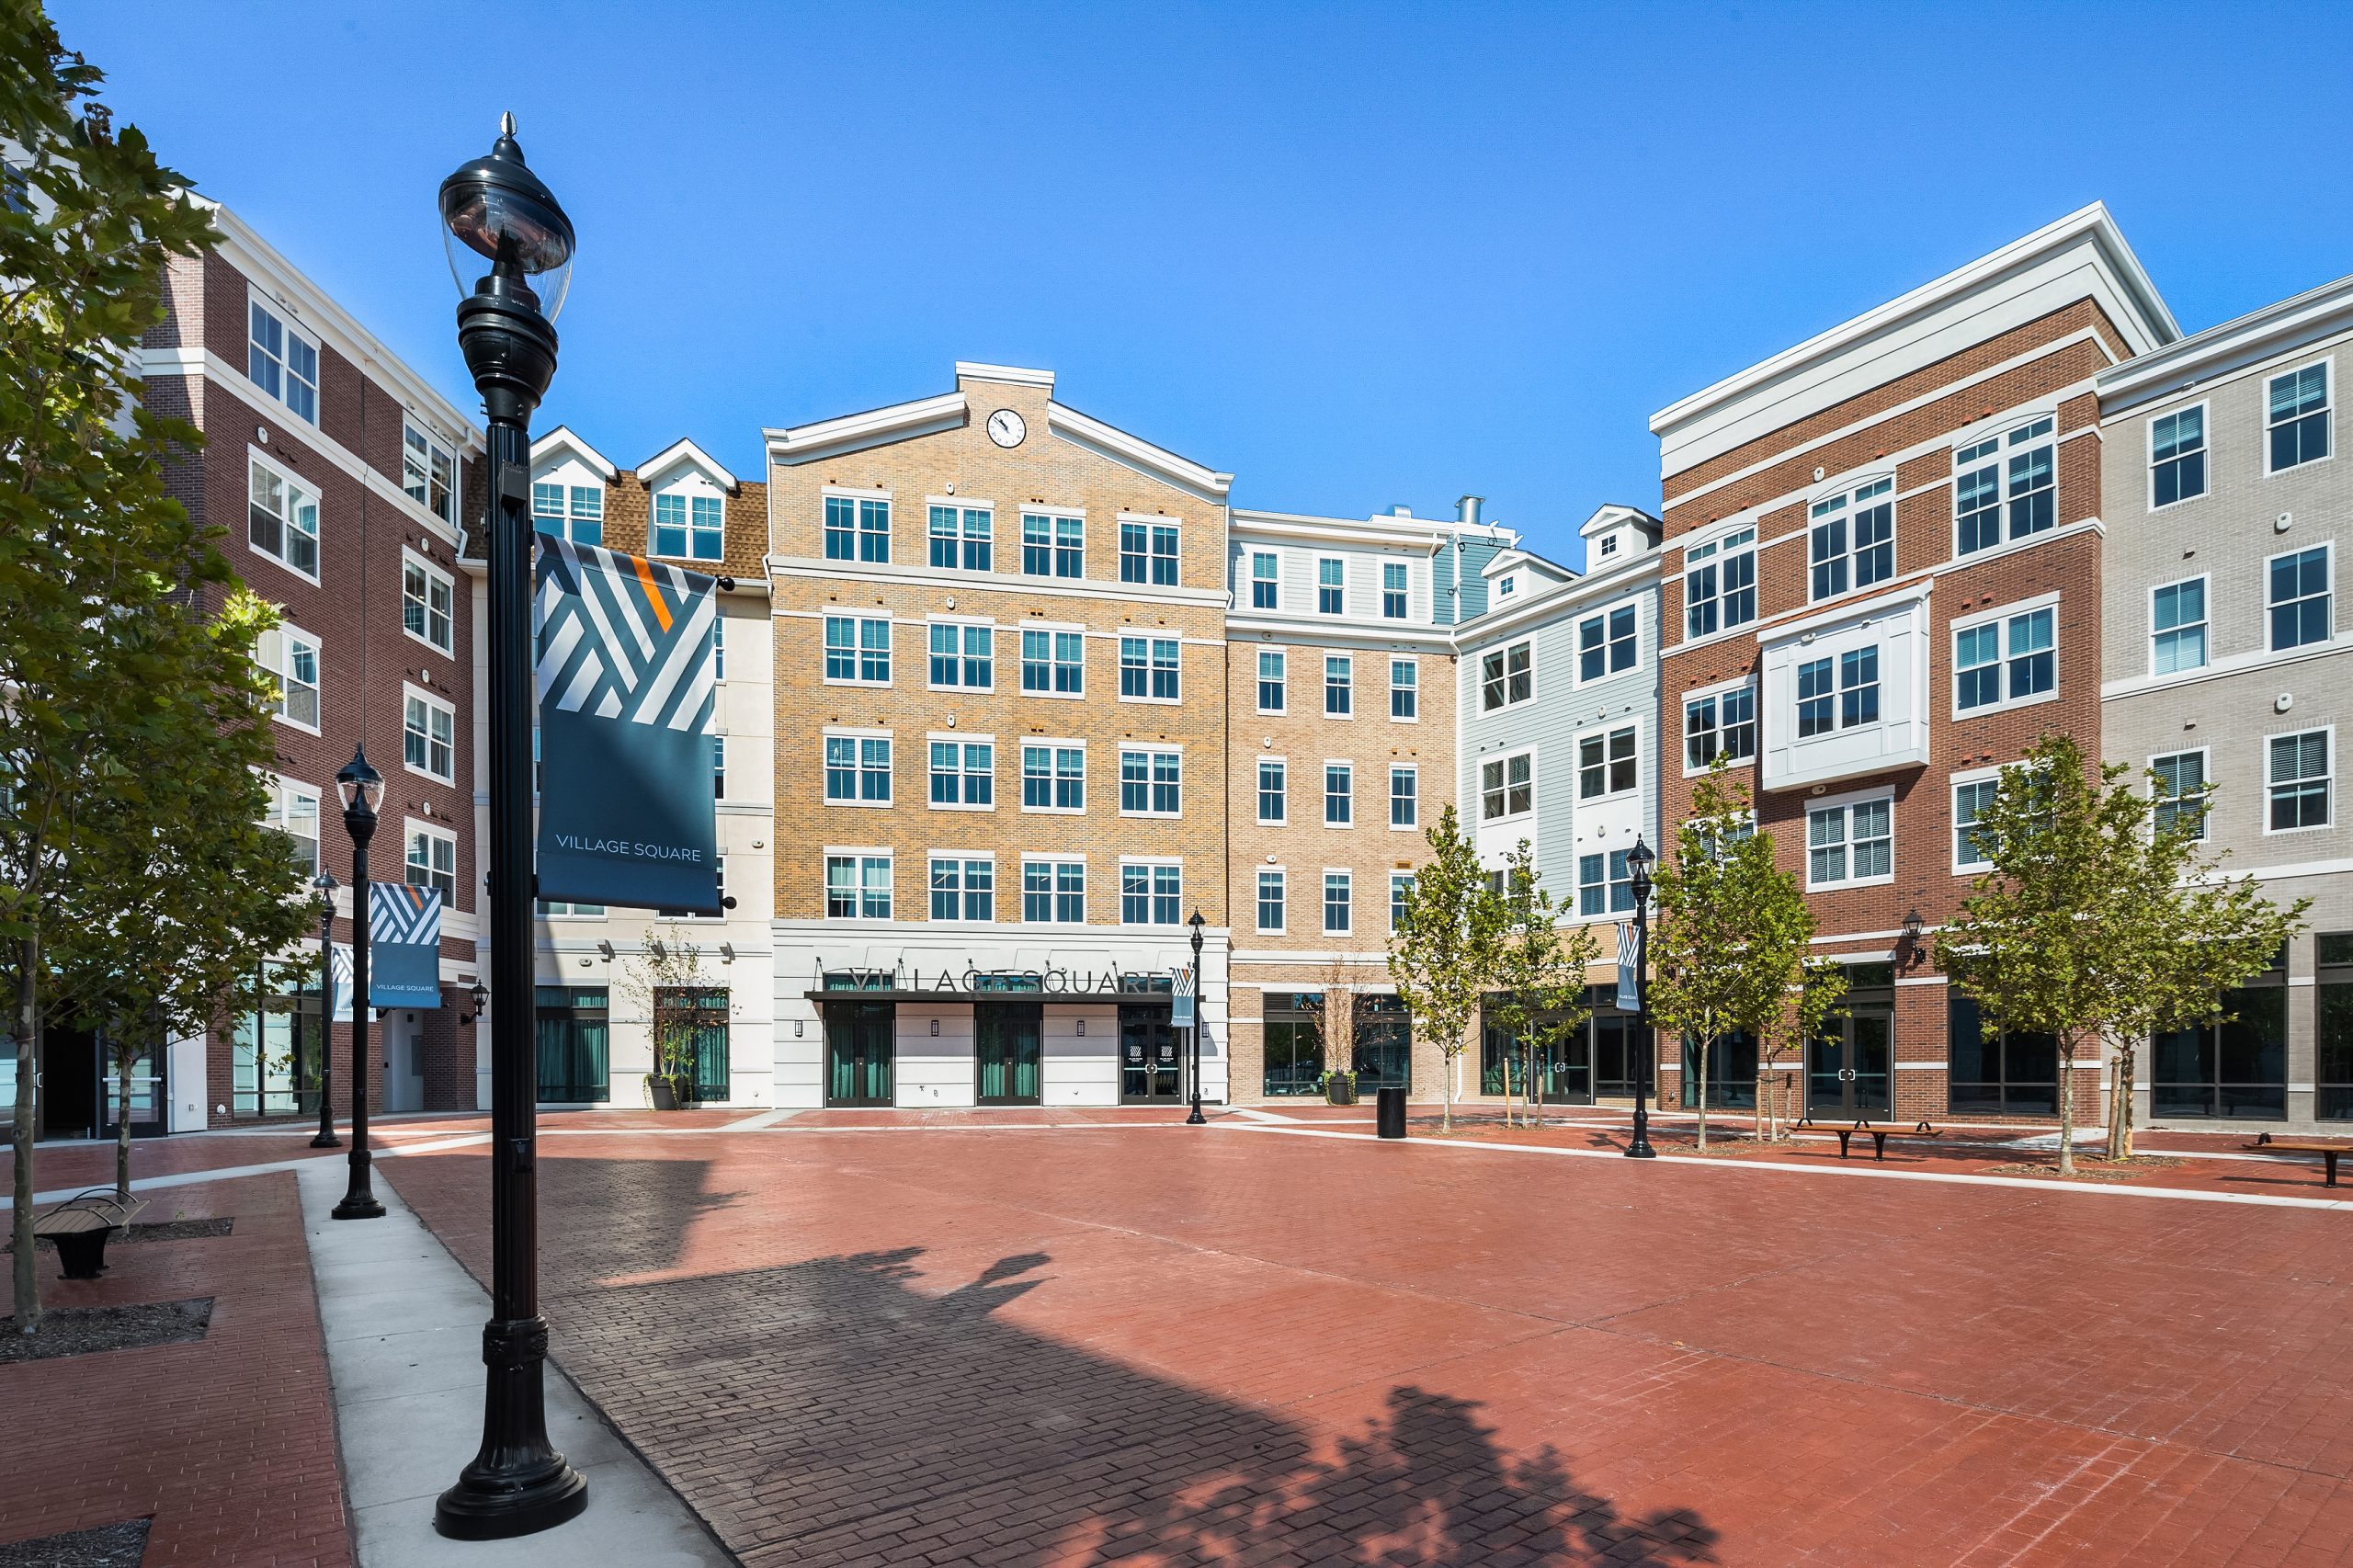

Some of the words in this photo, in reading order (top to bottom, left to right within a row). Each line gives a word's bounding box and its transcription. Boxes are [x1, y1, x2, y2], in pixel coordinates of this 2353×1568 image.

[554, 834, 630, 855] VILLAGE
[633, 843, 701, 862] SQUARE
[375, 983, 404, 992] VILLAGE
[406, 984, 434, 993] SQUARE
[848, 968, 1007, 993] VILLAGE
[1021, 970, 1164, 994] SQUARE
